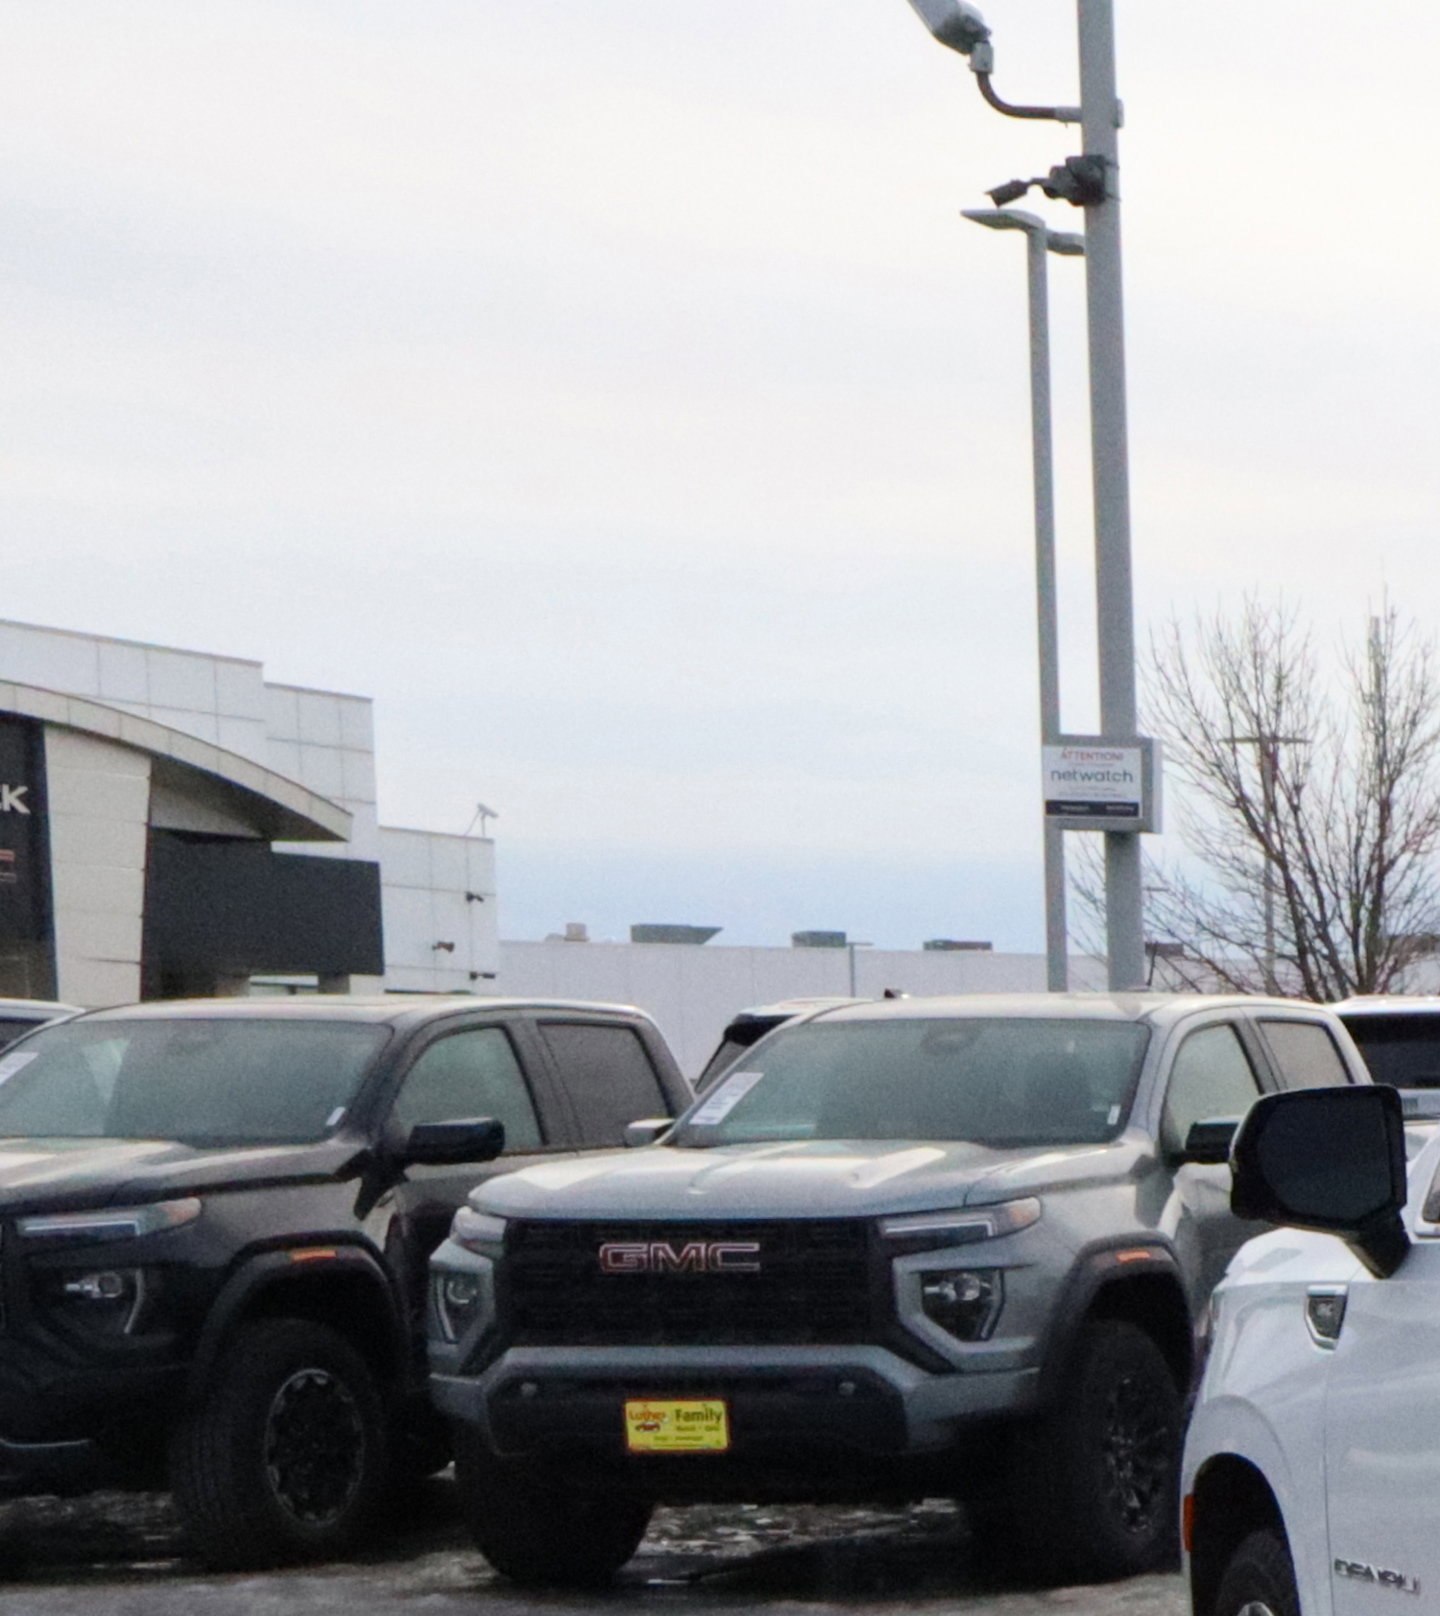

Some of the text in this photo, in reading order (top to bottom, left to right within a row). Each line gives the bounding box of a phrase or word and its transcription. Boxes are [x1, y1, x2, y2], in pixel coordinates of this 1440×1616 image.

[1050, 769, 1134, 783] netwatch
[0, 783, 31, 815] K
[599, 1242, 760, 1273] GMC
[675, 1408, 722, 1424] Family
